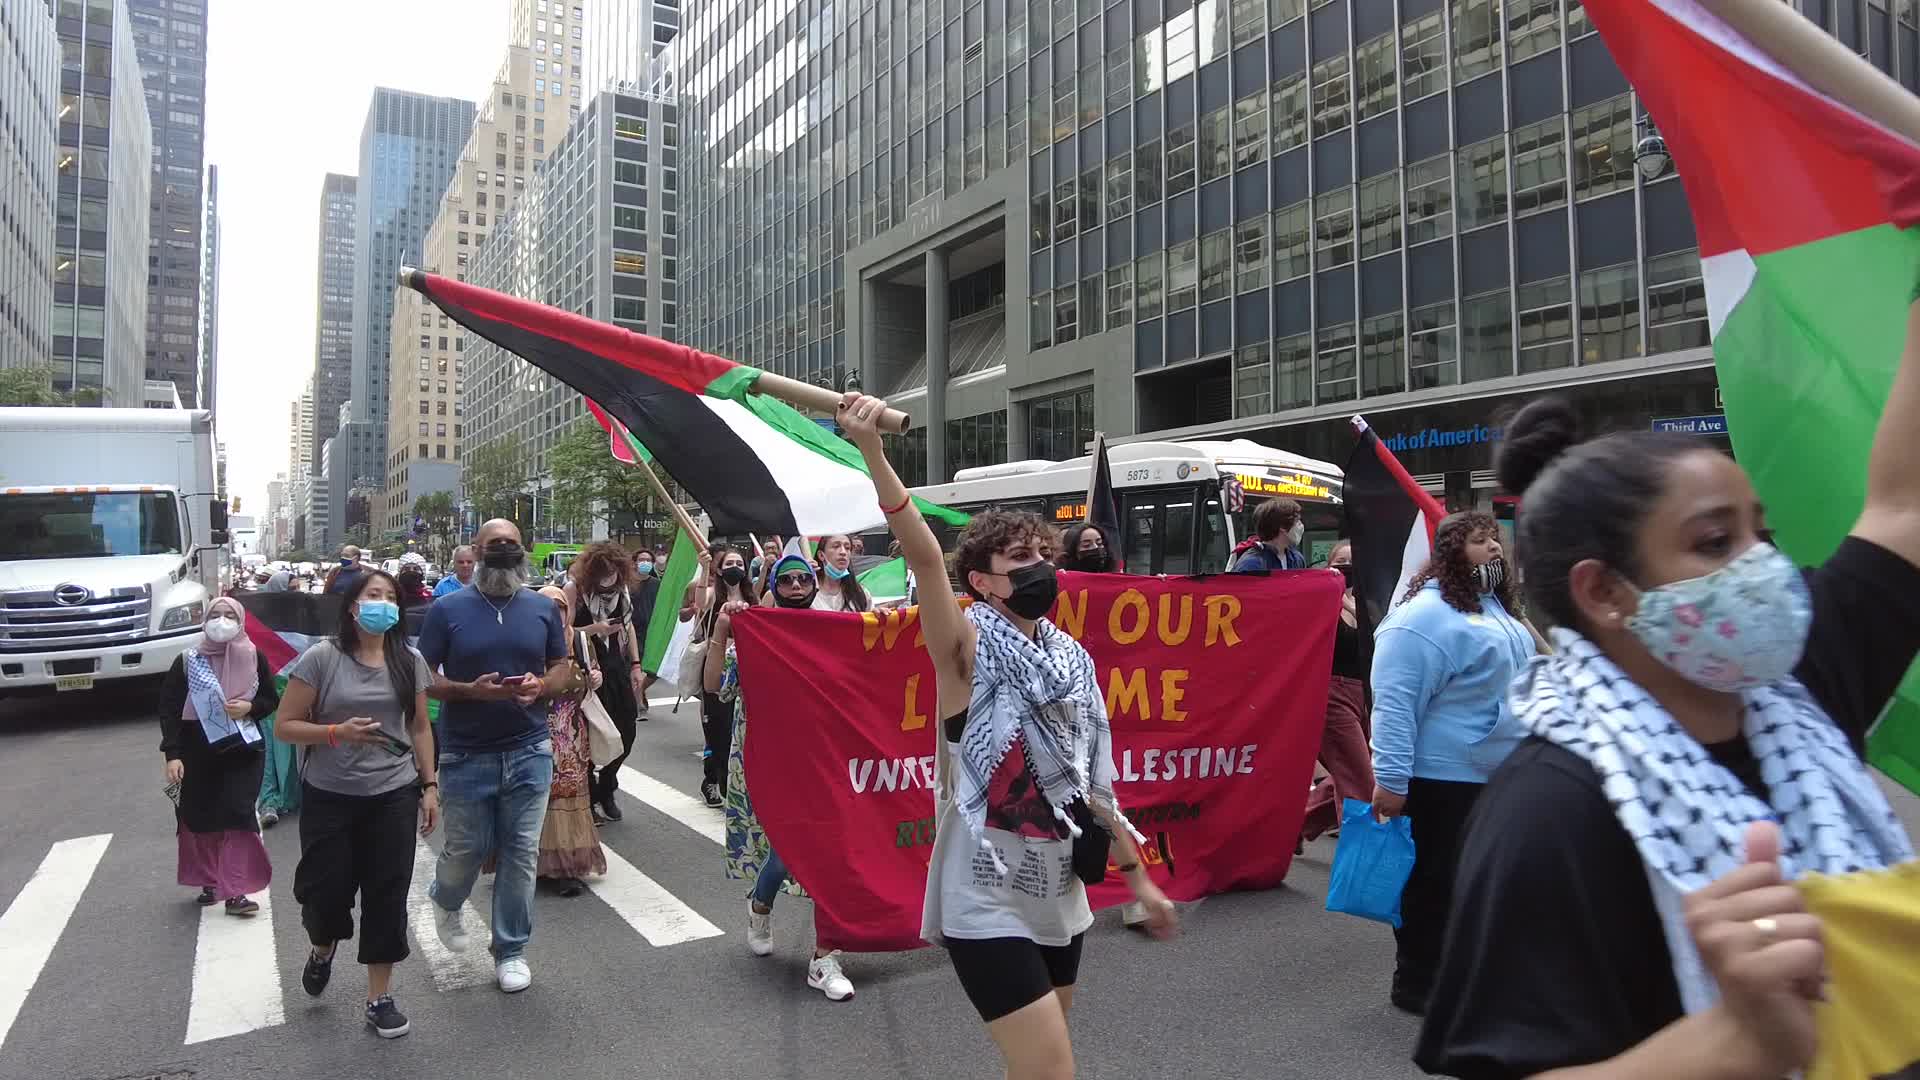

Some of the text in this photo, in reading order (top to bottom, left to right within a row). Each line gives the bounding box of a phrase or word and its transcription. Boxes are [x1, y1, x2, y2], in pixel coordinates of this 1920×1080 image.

[1662, 420, 1721, 432] Third Ave
[1409, 428, 1427, 449] of
[1127, 469, 1149, 481] 5873
[1107, 588, 1243, 648] OUR
[848, 755, 936, 794] UNITE
